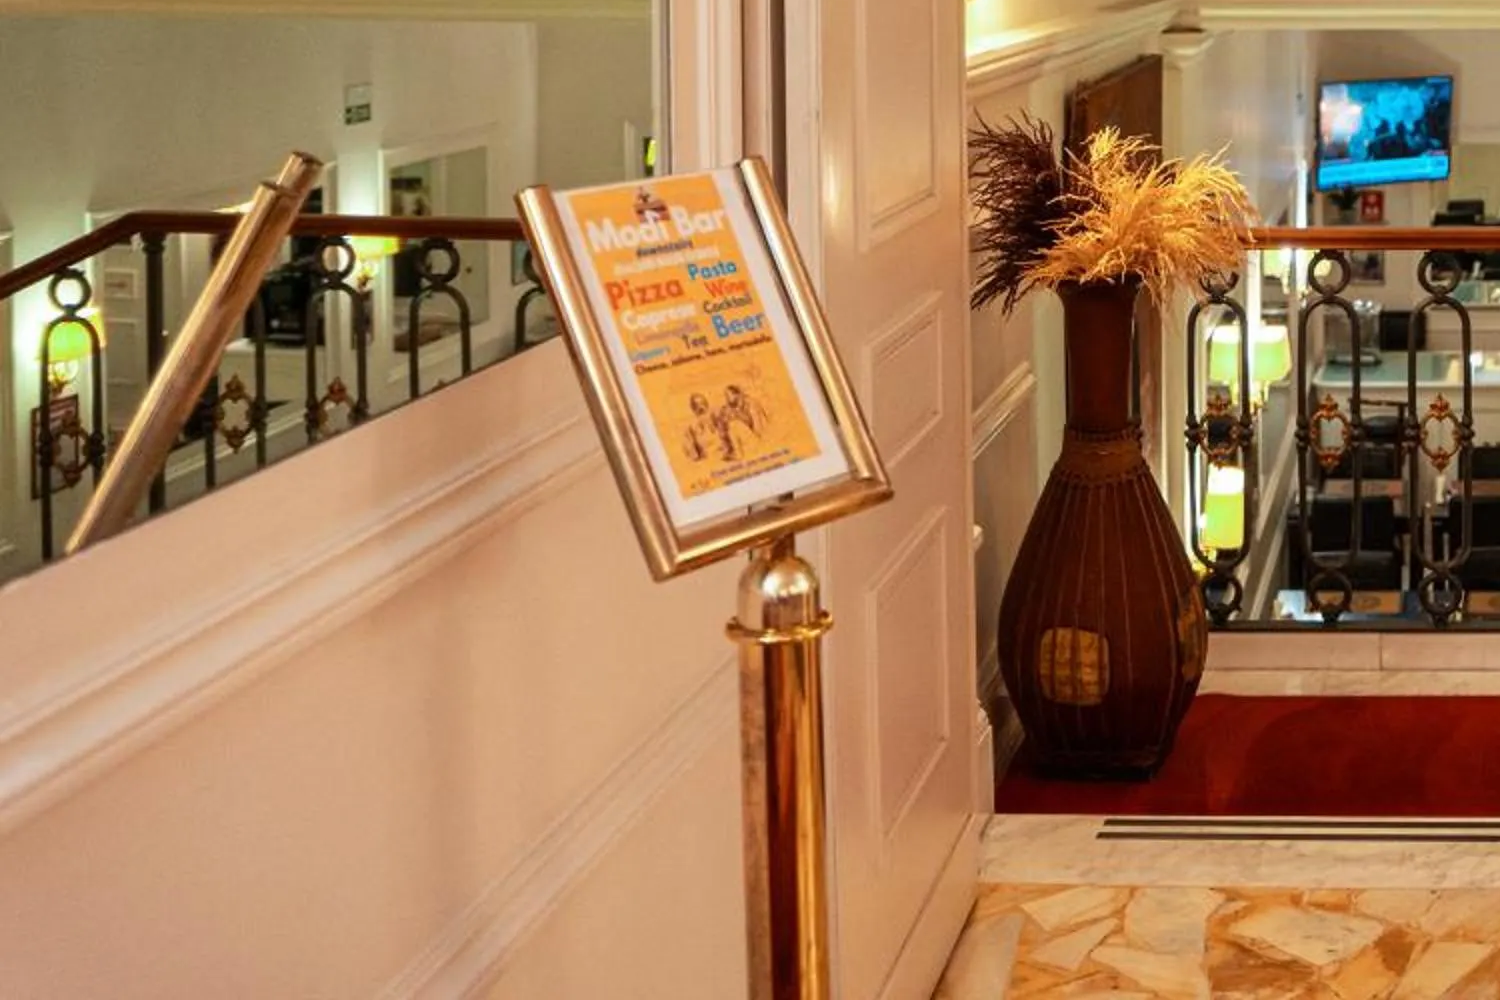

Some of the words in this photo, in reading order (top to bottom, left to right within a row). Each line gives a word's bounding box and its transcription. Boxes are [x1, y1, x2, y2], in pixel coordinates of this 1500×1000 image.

[671, 206, 726, 239] Bar
[688, 261, 738, 281] Pasta
[606, 279, 685, 311] Pizza
[704, 278, 748, 298] Wine
[703, 292, 753, 314] Cocktail
[711, 312, 765, 339] Beer
[681, 333, 708, 350] Tea
